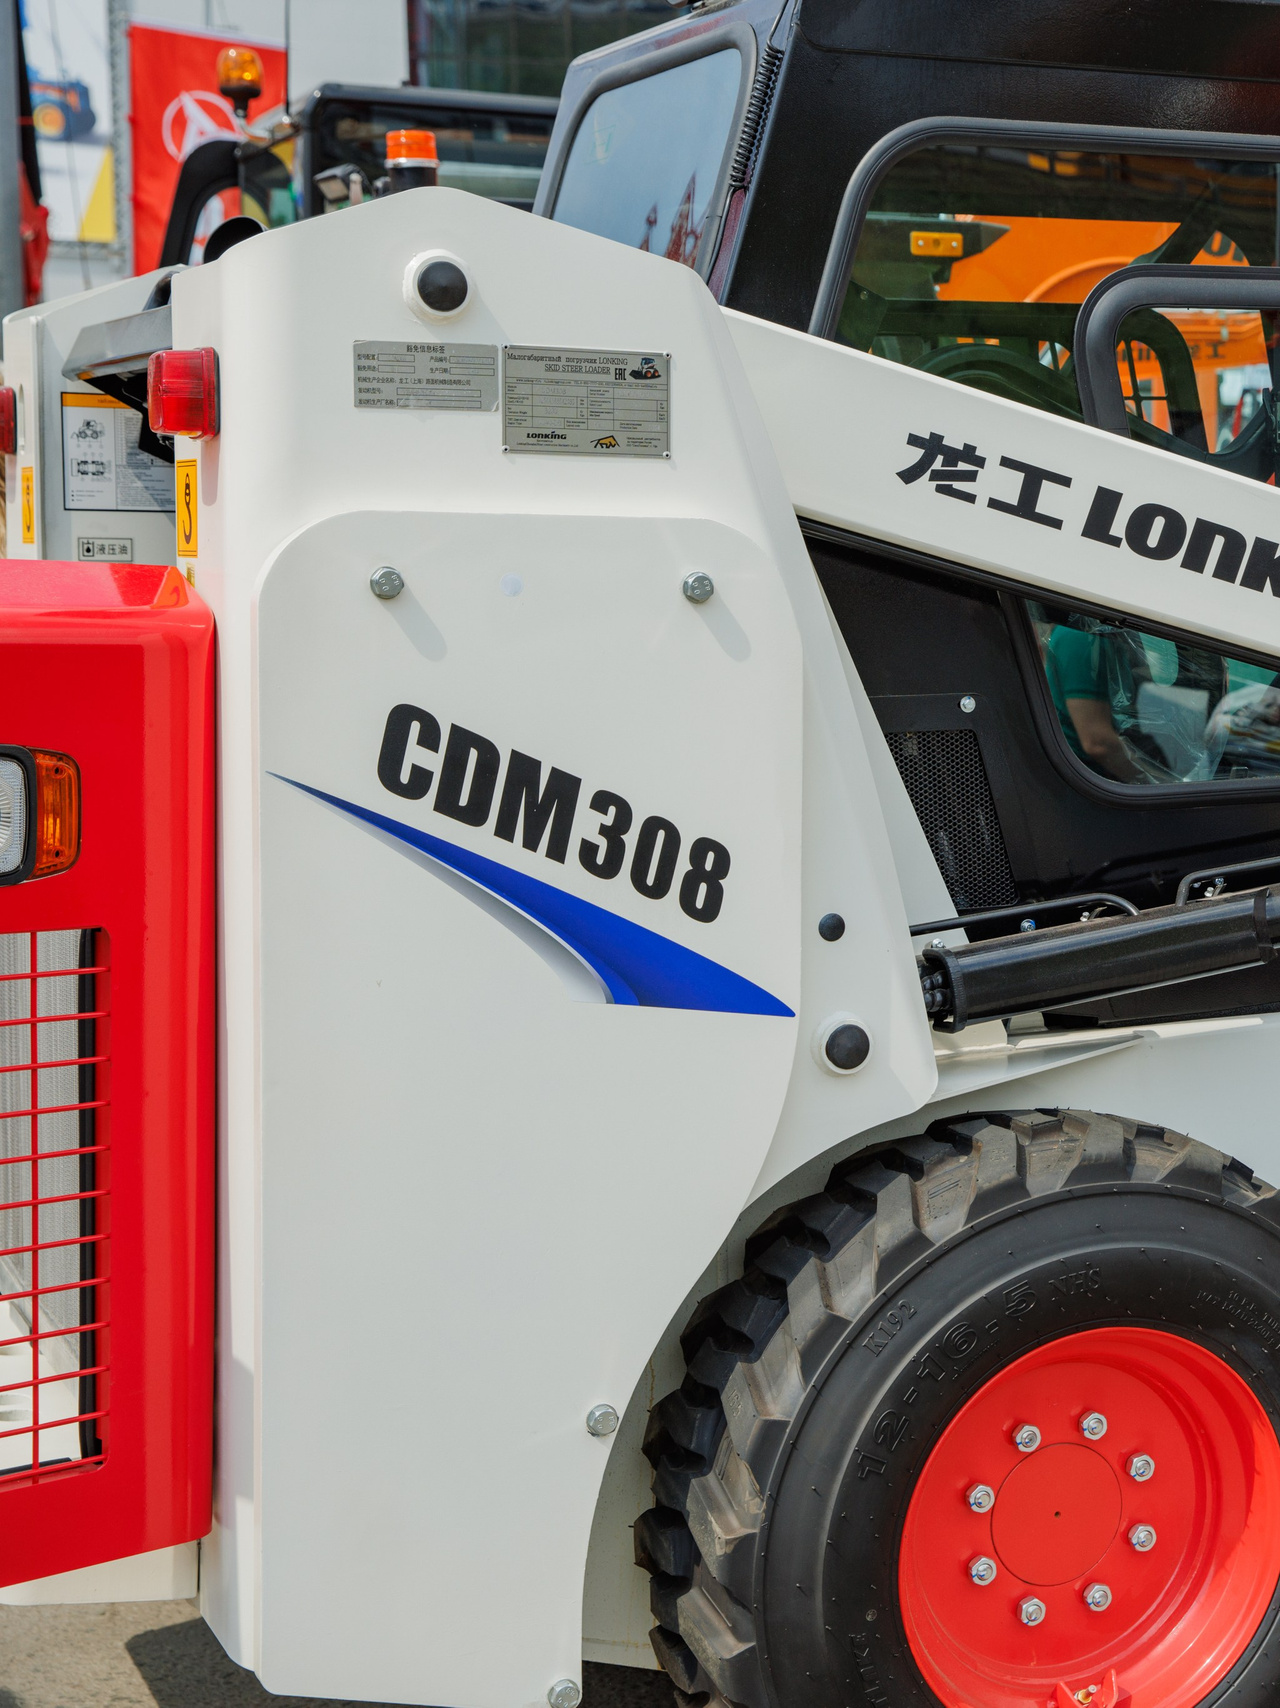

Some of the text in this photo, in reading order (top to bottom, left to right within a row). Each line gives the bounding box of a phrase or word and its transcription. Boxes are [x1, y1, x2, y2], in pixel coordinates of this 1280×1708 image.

[506, 352, 562, 363] Малогабаритный
[598, 357, 628, 366] LONKING
[545, 363, 611, 375] SKID STEER LOADER
[526, 431, 567, 440] LONKING
[896, 431, 1072, 531] 龙工
[96, 543, 128, 555] 液压油
[377, 703, 731, 923] CDM308
[1048, 1268, 1101, 1298] NHS
[862, 1299, 918, 1357] K192
